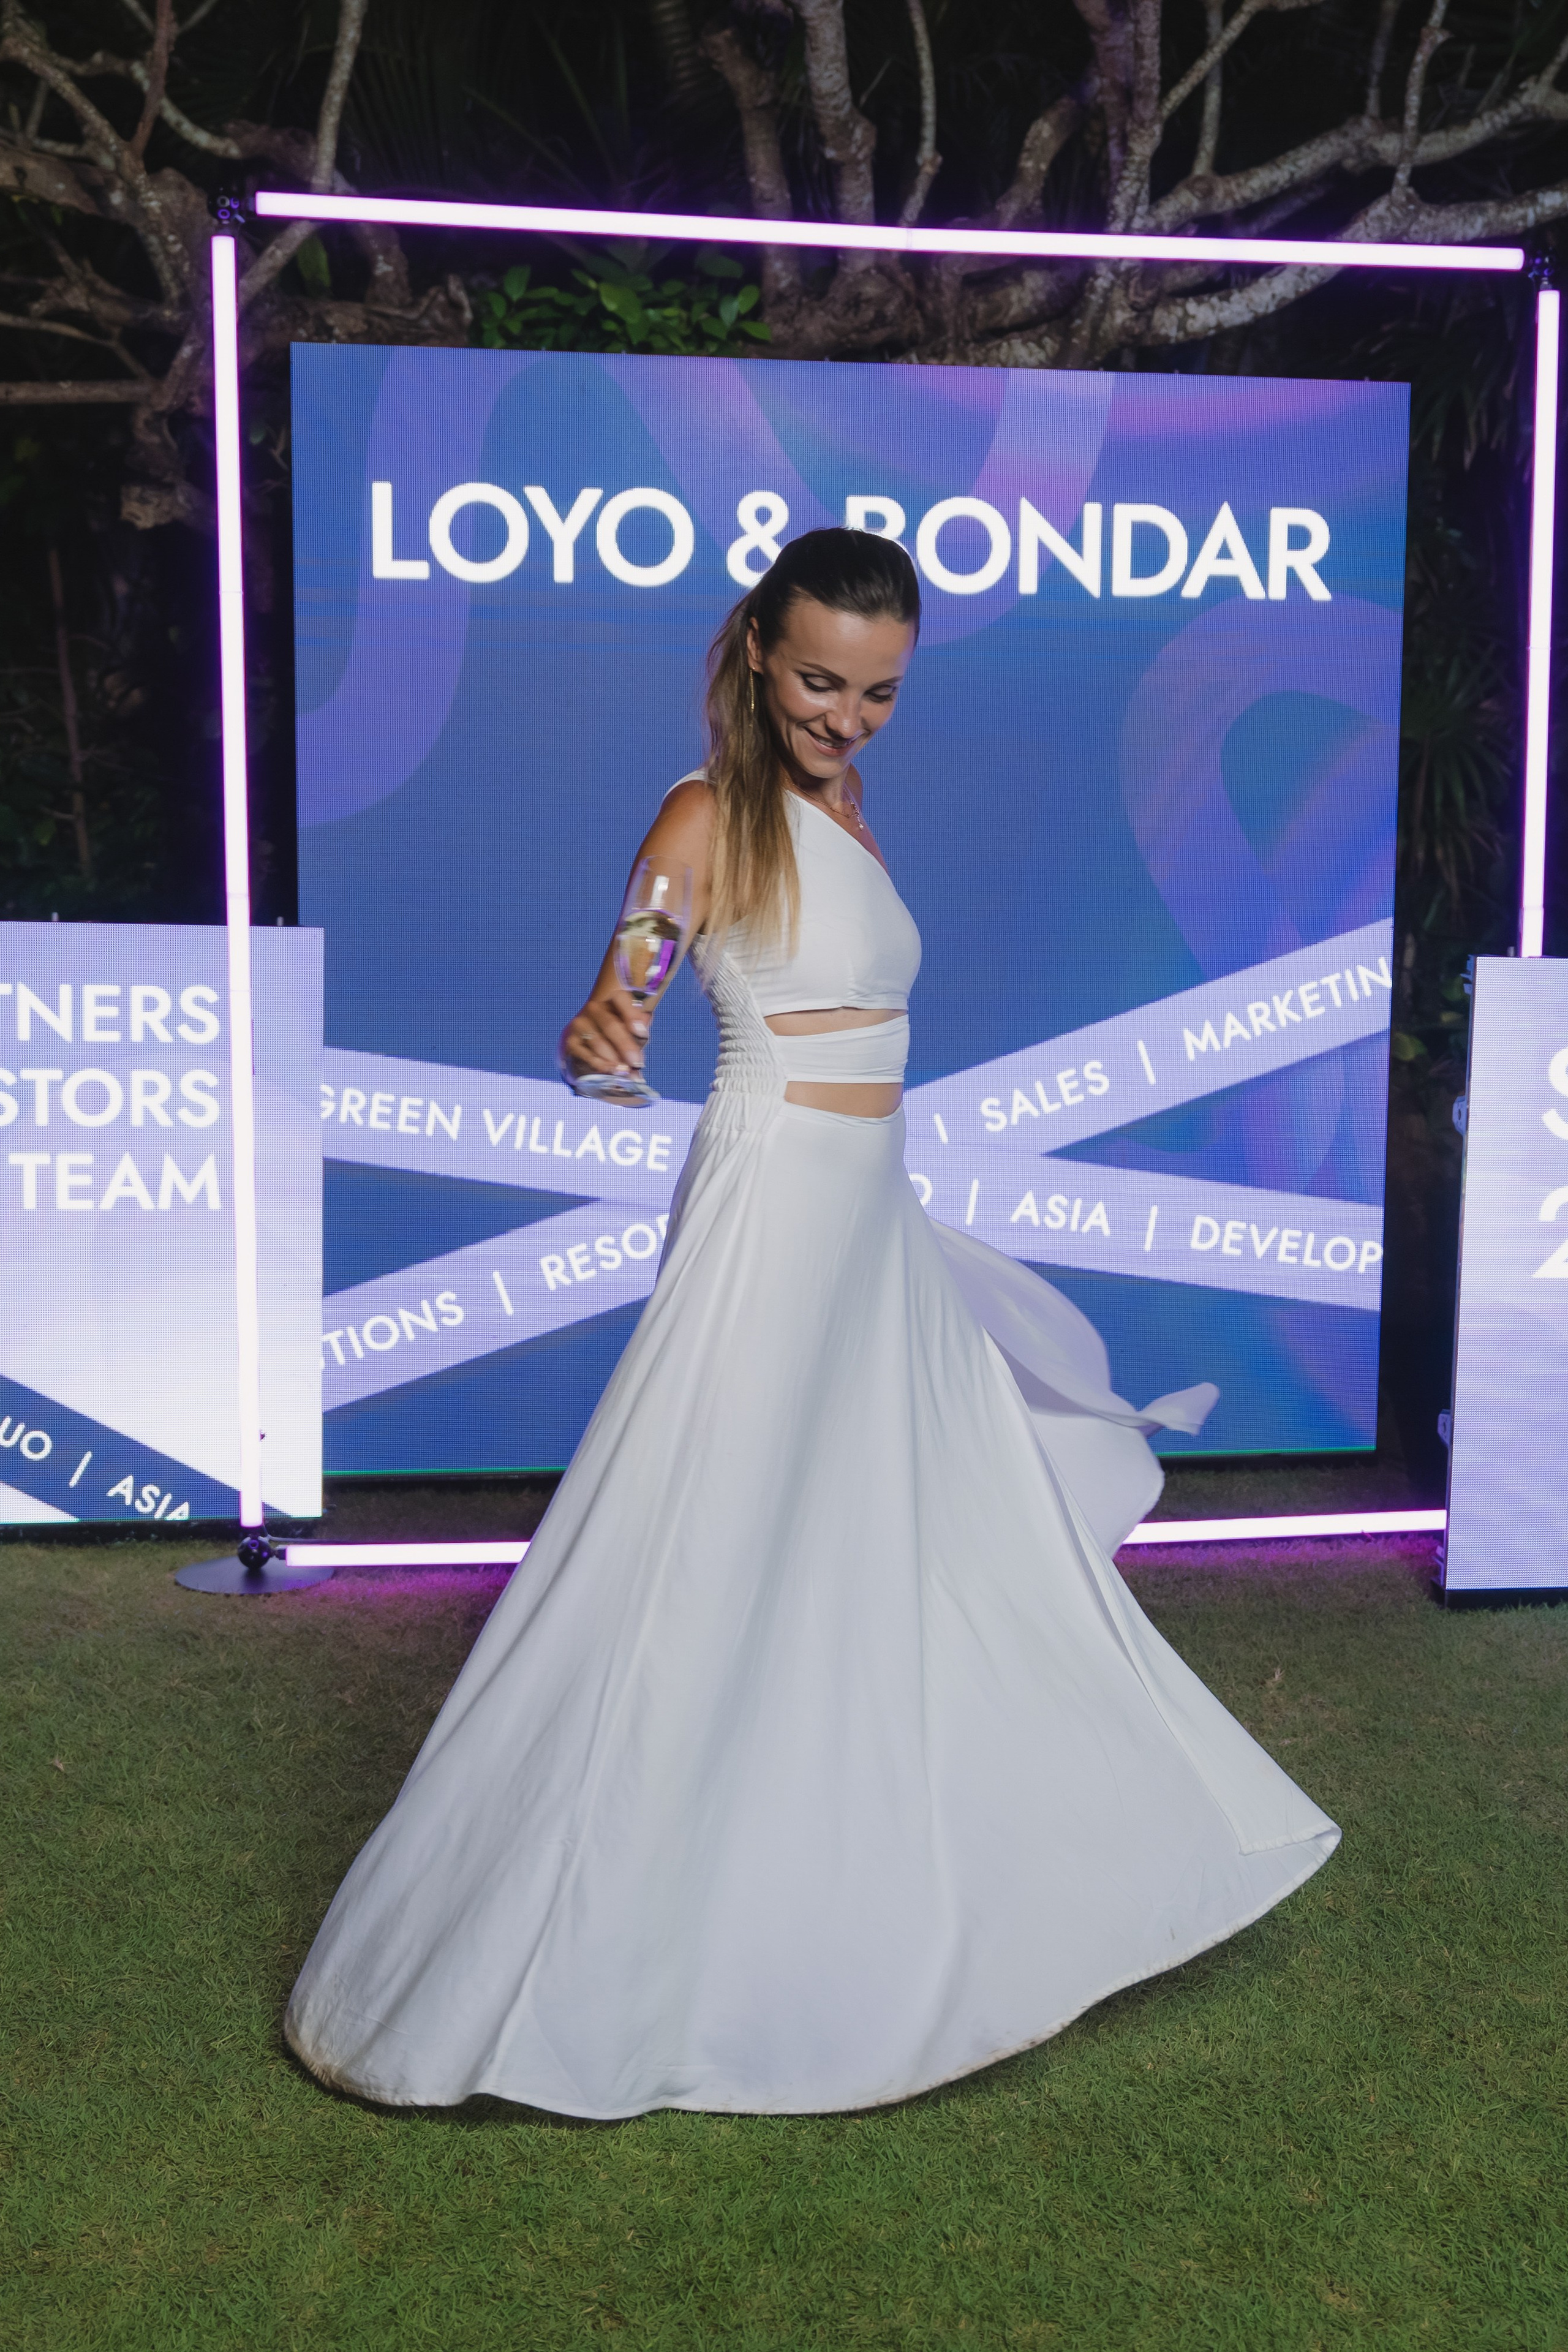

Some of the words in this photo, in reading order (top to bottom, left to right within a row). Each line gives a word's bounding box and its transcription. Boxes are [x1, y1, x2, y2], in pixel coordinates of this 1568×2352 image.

[371, 481, 695, 587] LOYO
[726, 490, 790, 587] &
[8, 1152, 222, 1210] TEAM
[319, 1291, 465, 1370] TIONS
[540, 1213, 669, 1291] RESO
[980, 1060, 1110, 1132] SALES
[1182, 956, 1392, 1062] MARKETIN
[483, 1109, 673, 1171] VILLAGE
[1010, 1191, 1110, 1237] ASIA
[1189, 1215, 1382, 1273] DEVELOP
[107, 1474, 190, 1520] ASIA
